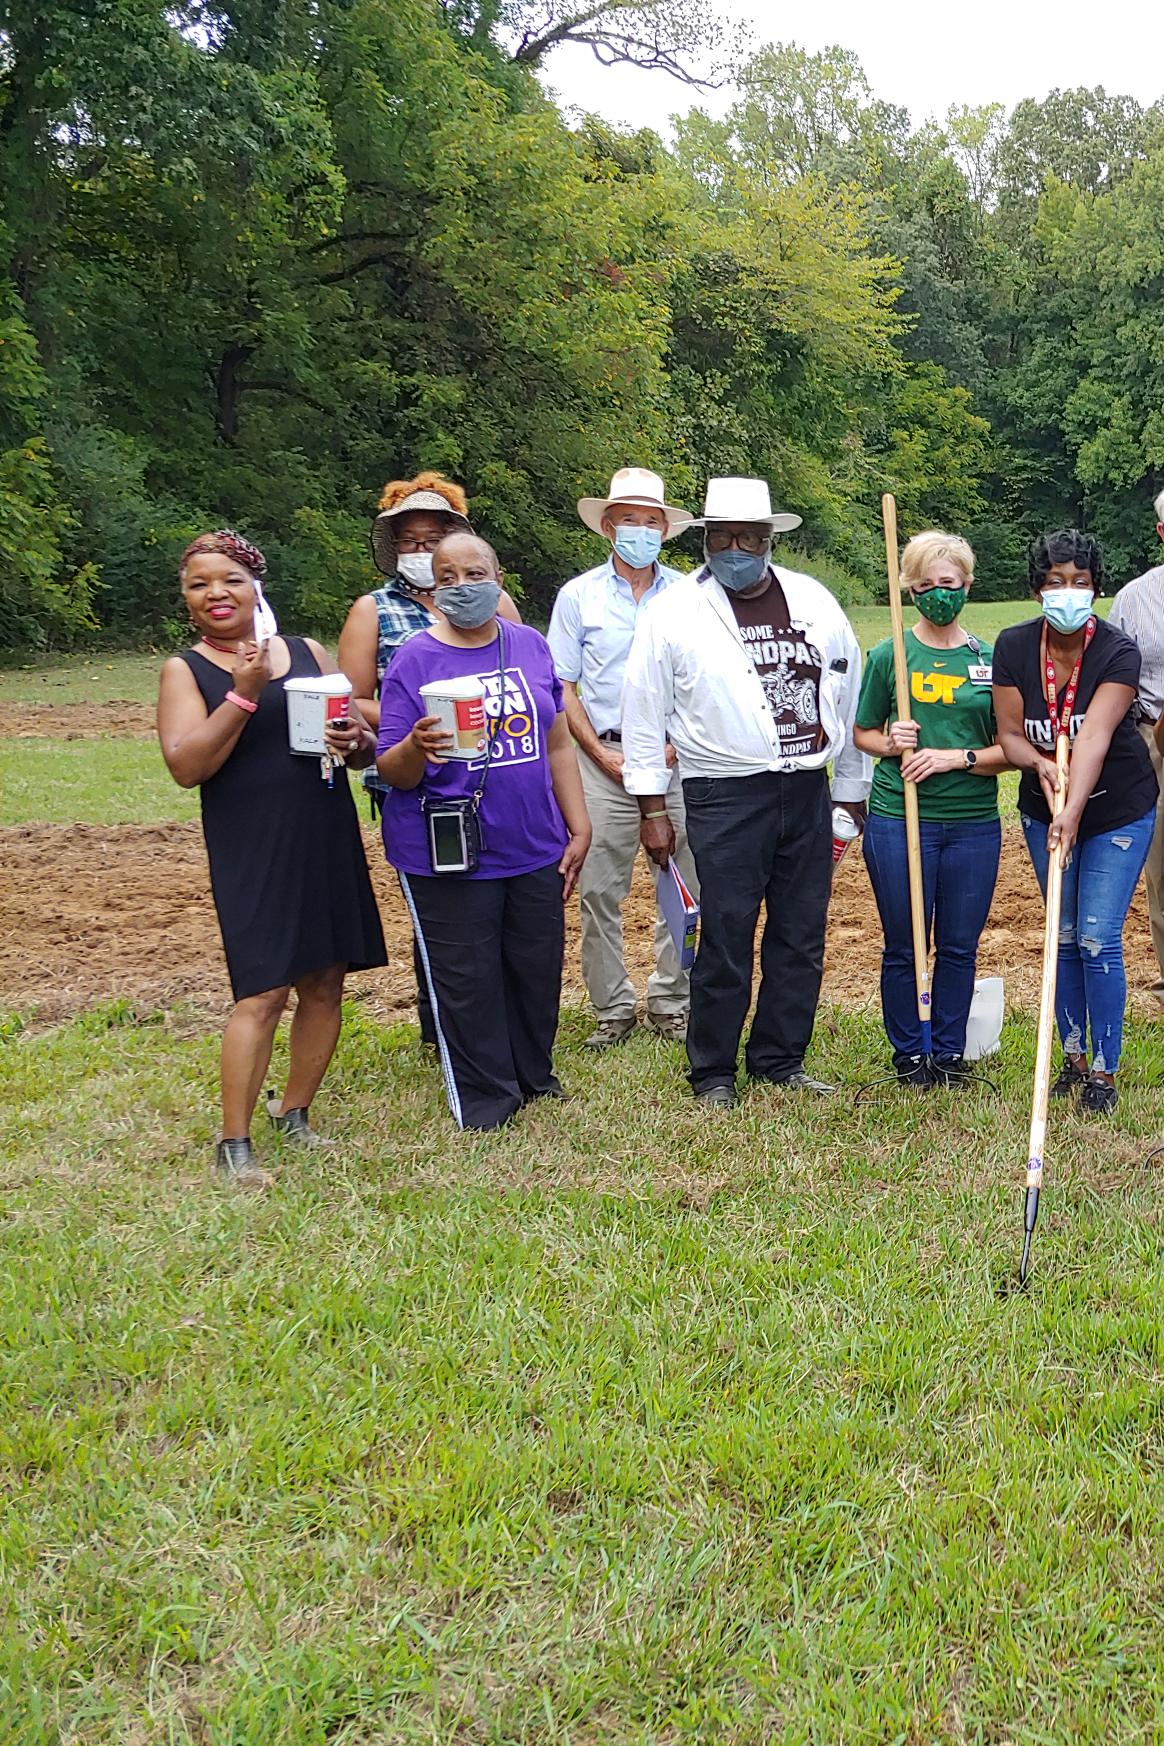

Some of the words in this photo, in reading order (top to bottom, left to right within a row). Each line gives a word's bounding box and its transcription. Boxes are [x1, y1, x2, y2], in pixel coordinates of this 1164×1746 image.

[740, 625, 774, 641] SOME
[745, 640, 822, 668] NDPAS
[911, 671, 968, 704] UT
[486, 714, 532, 740] PO
[777, 723, 797, 736] INGO
[491, 735, 534, 759] 018
